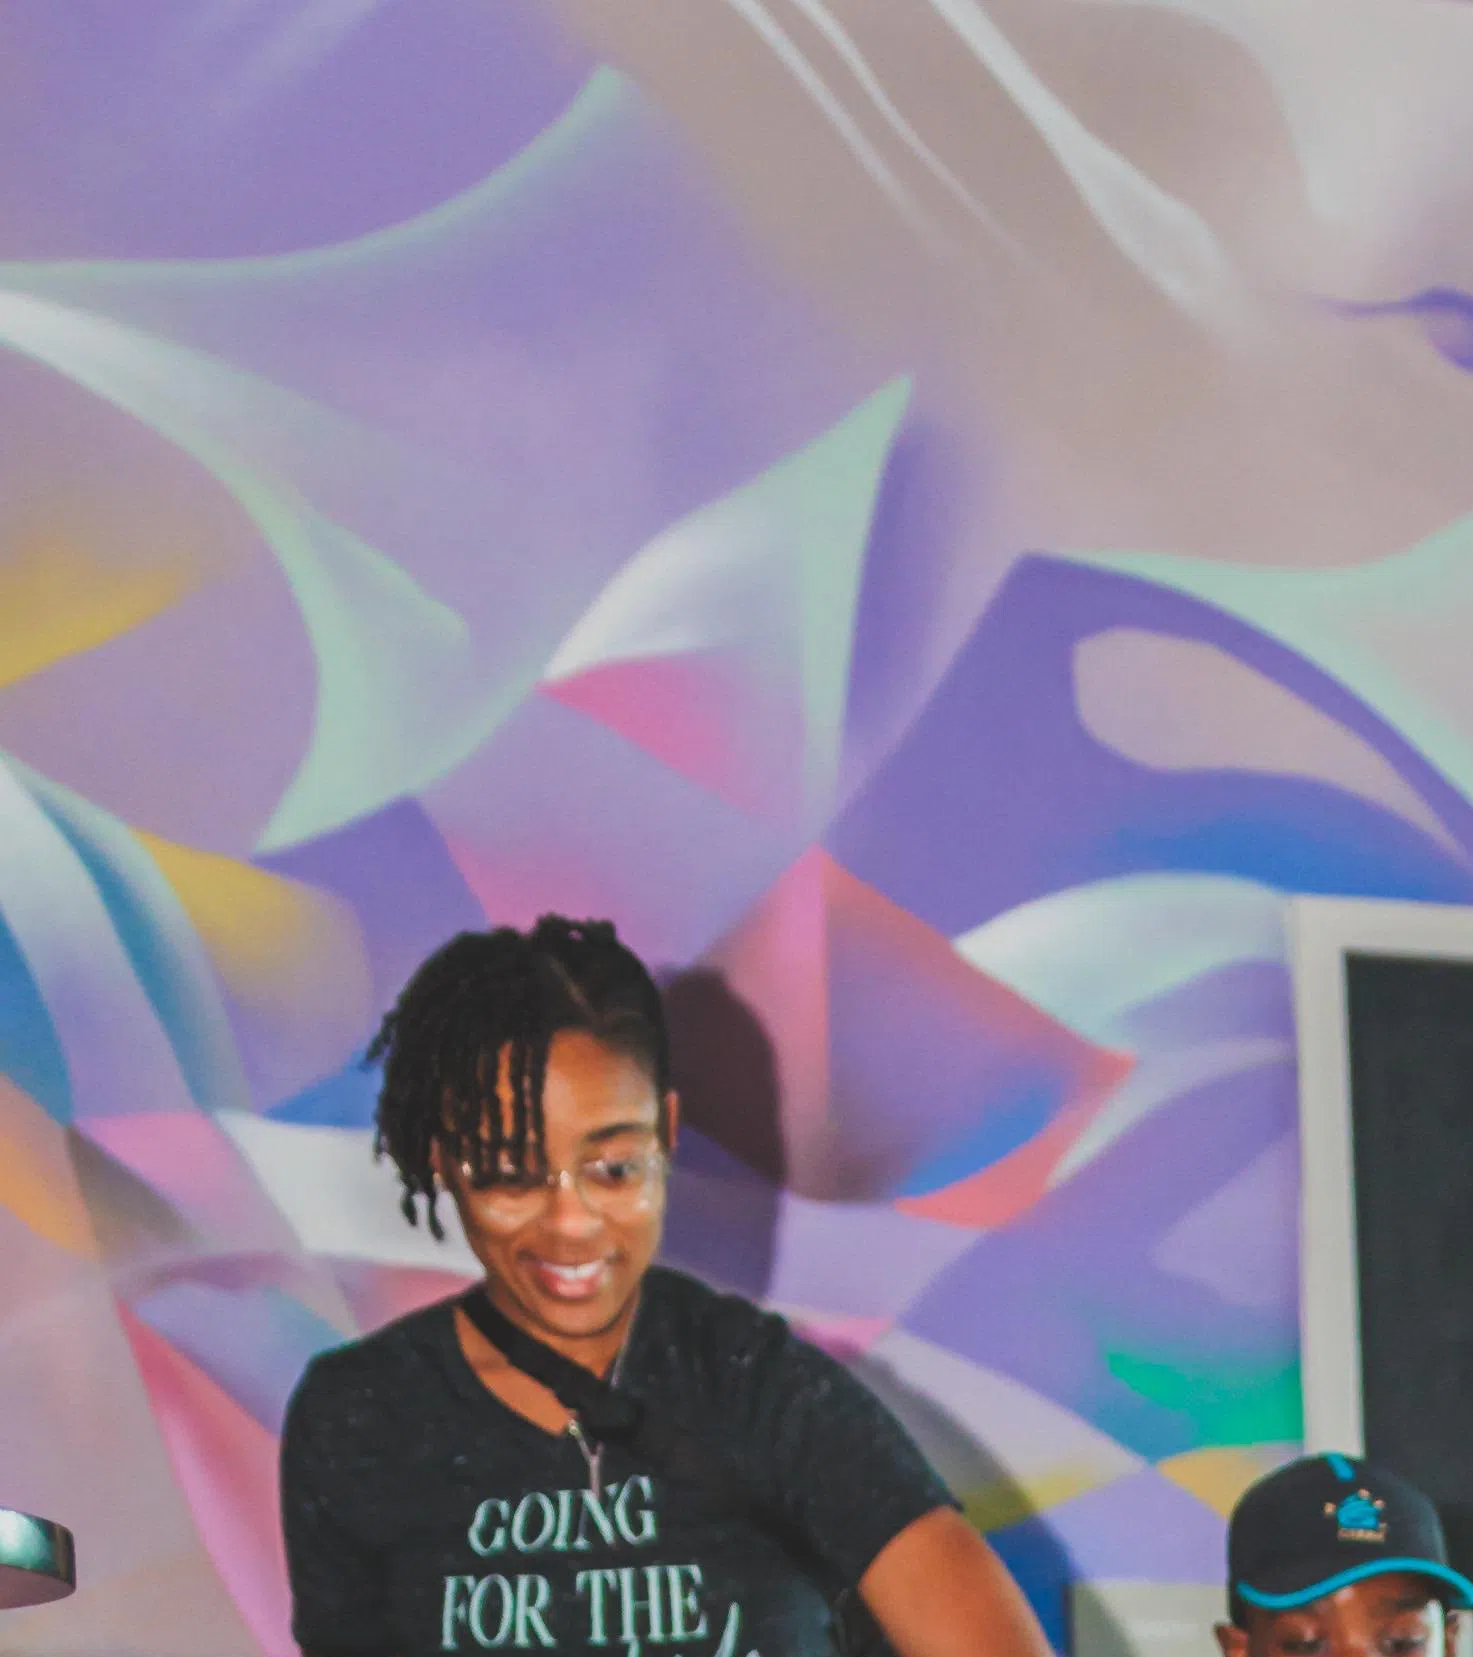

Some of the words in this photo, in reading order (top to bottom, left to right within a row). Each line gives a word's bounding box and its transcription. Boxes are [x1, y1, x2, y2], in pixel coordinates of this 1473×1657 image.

[468, 1474, 658, 1557] GOING
[441, 1572, 557, 1650] FOR
[575, 1563, 709, 1646] THE
